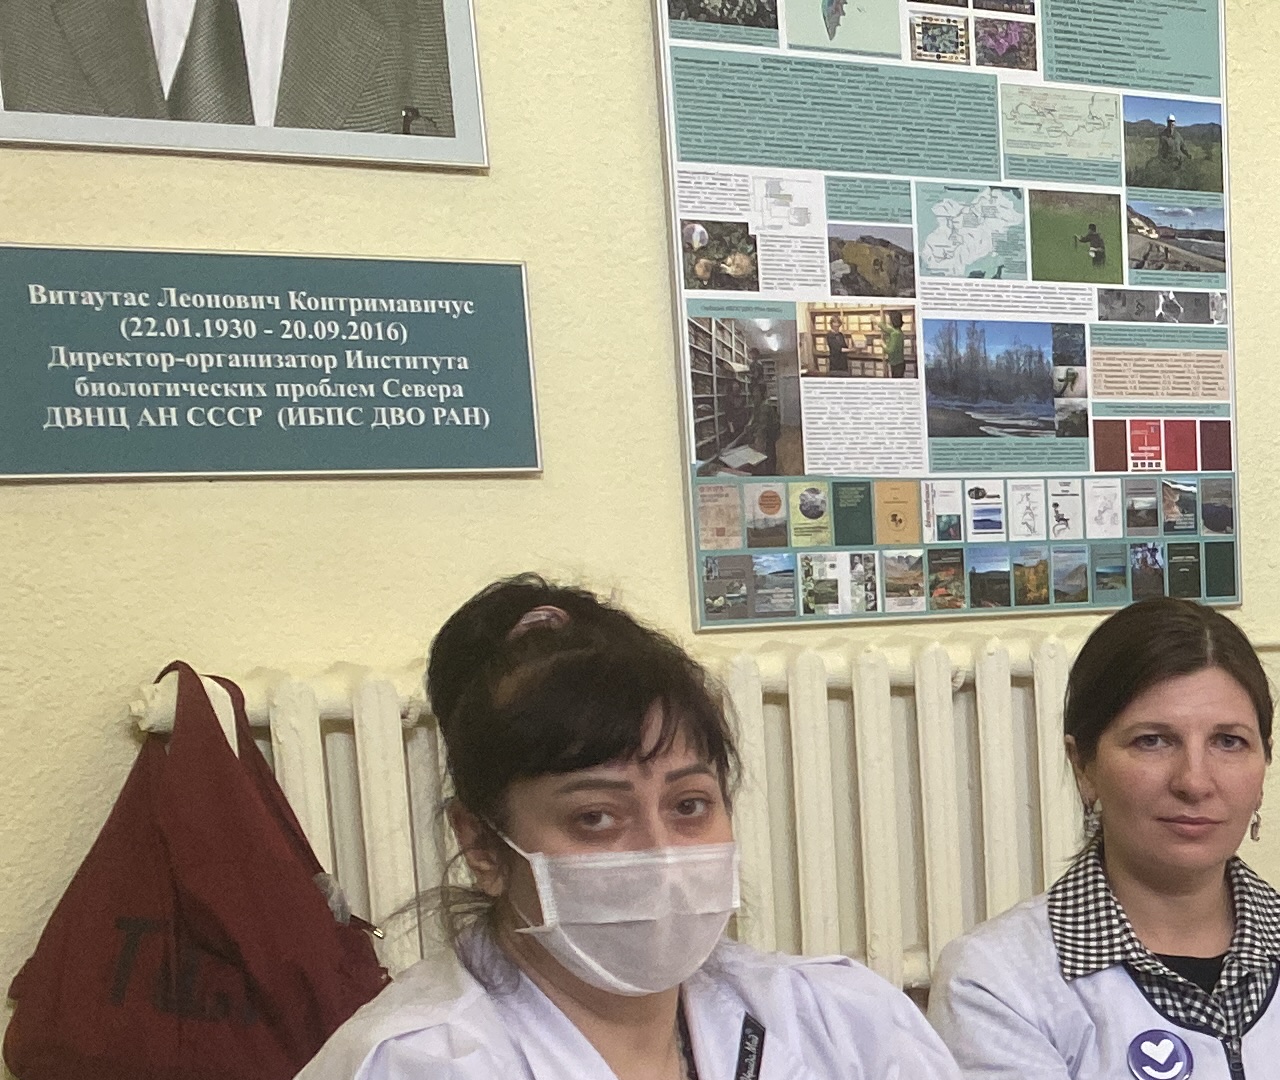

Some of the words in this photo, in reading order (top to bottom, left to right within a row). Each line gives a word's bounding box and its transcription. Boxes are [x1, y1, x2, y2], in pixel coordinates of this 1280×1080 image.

[28, 283, 150, 311] Витаутас
[157, 287, 280, 311] Леонович
[288, 291, 475, 316] Контримавичус
[119, 316, 256, 340] (22.01.1930
[281, 320, 408, 345] 20.09.2016)
[48, 346, 338, 373] Директор-организатор
[345, 350, 469, 372] Института
[75, 377, 267, 398] биологических
[275, 380, 376, 403] проблем
[382, 379, 464, 402] Севера
[43, 406, 130, 431] ДВНЦ
[137, 407, 178, 428] АН
[186, 407, 262, 428] СССР
[278, 407, 364, 429] (ИБПС
[371, 407, 425, 430] ДВО
[432, 407, 490, 430] РАН)
